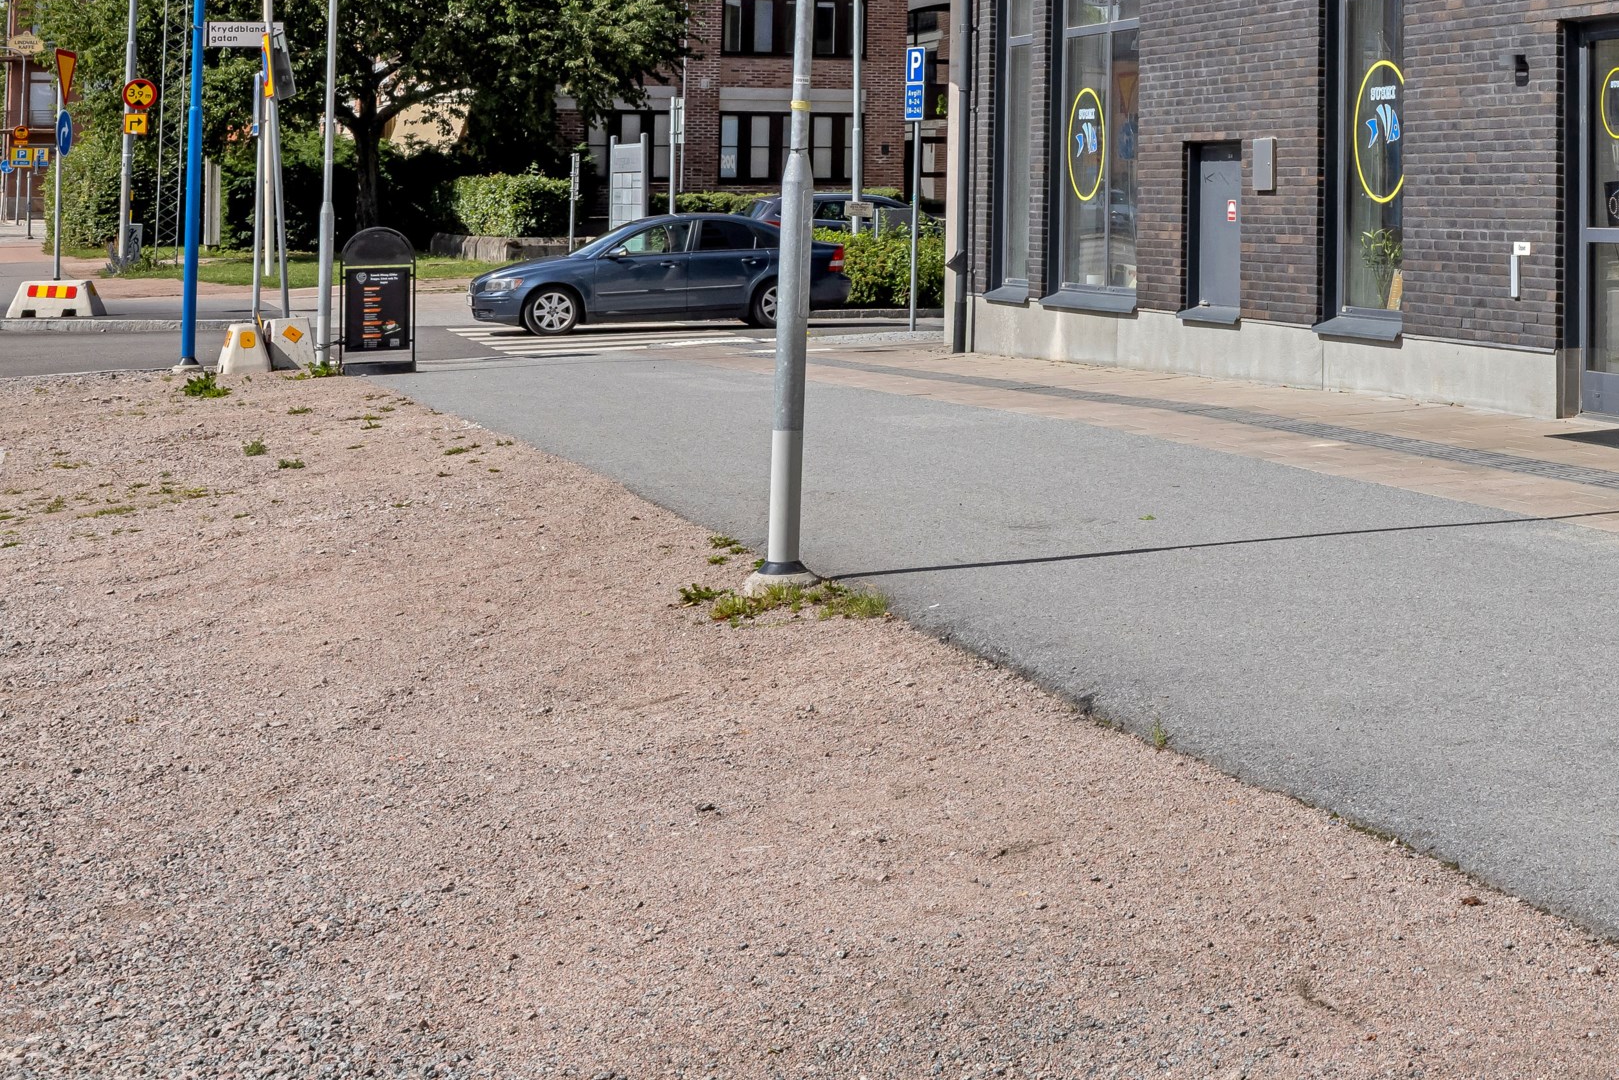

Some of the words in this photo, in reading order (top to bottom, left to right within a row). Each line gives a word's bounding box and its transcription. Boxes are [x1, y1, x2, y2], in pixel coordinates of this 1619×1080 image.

[211, 25, 281, 34] Kryddblandr-
[211, 35, 238, 43] gatan
[911, 52, 921, 79] P
[128, 89, 143, 99] 3,9
[908, 90, 921, 98] Avgift
